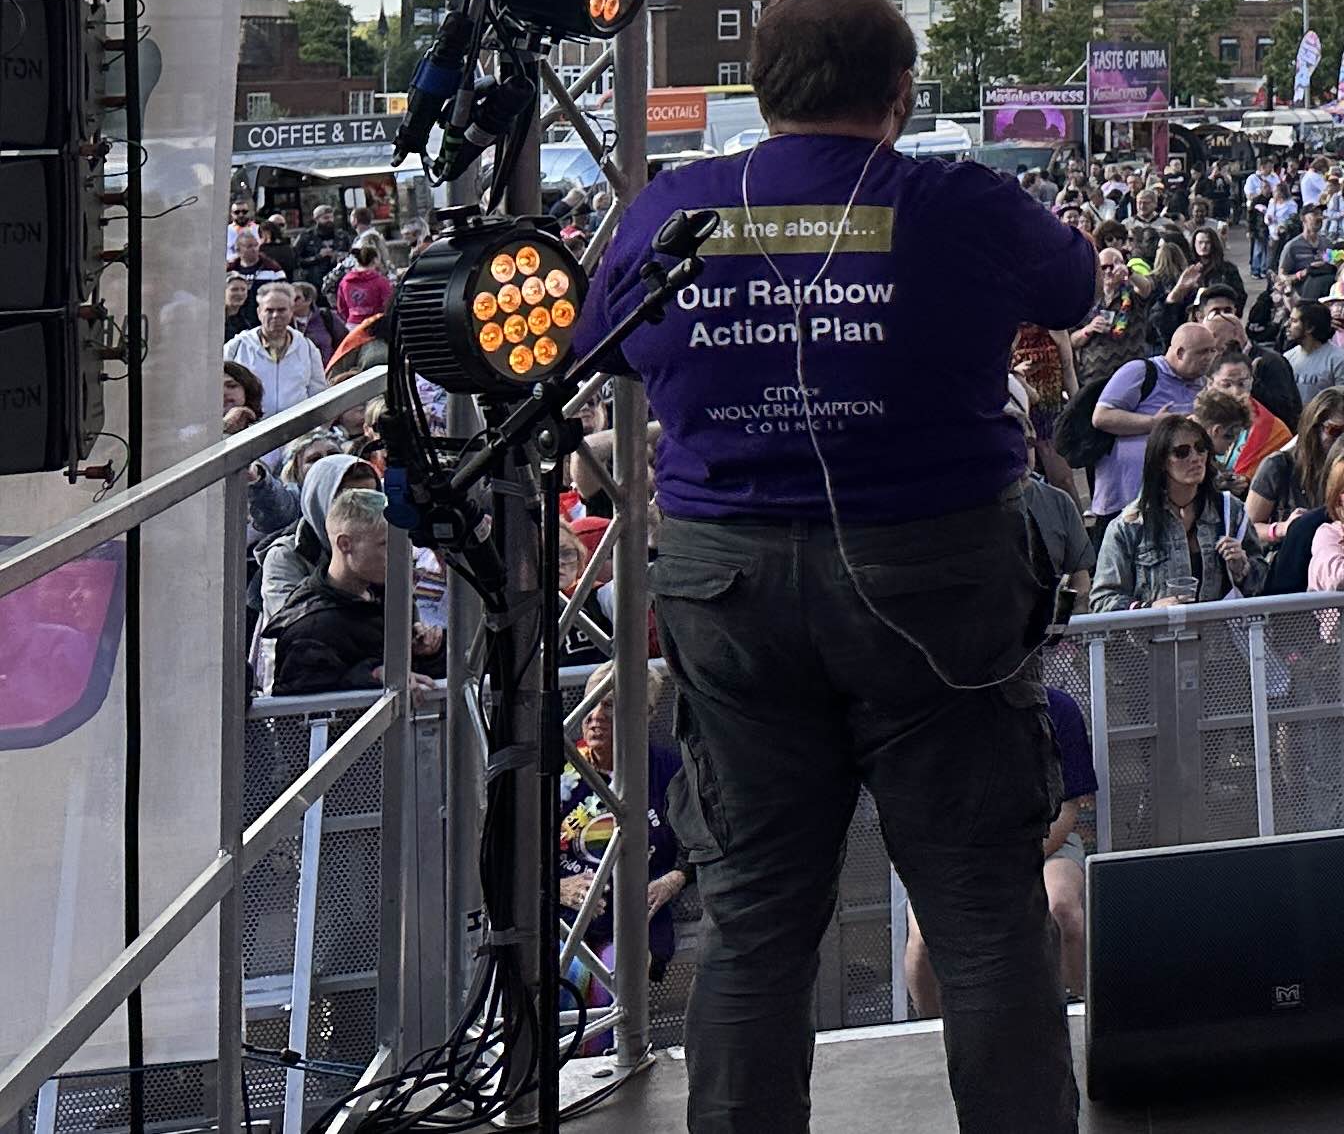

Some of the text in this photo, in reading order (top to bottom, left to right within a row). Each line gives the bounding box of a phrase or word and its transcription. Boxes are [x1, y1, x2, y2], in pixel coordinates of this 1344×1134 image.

[1093, 49, 1167, 72] TASTE OF INDIA
[914, 91, 931, 108] AR
[646, 103, 700, 122] COCKTAILS
[247, 120, 387, 149] COFFEE & TEA
[707, 217, 876, 240] sk me about...
[677, 278, 895, 310] Our Rainbow
[688, 316, 884, 348] Action Plan
[764, 386, 803, 401] CITY
[706, 401, 884, 421] WOLVERHAMPTON
[744, 419, 845, 434] COUNCIL
